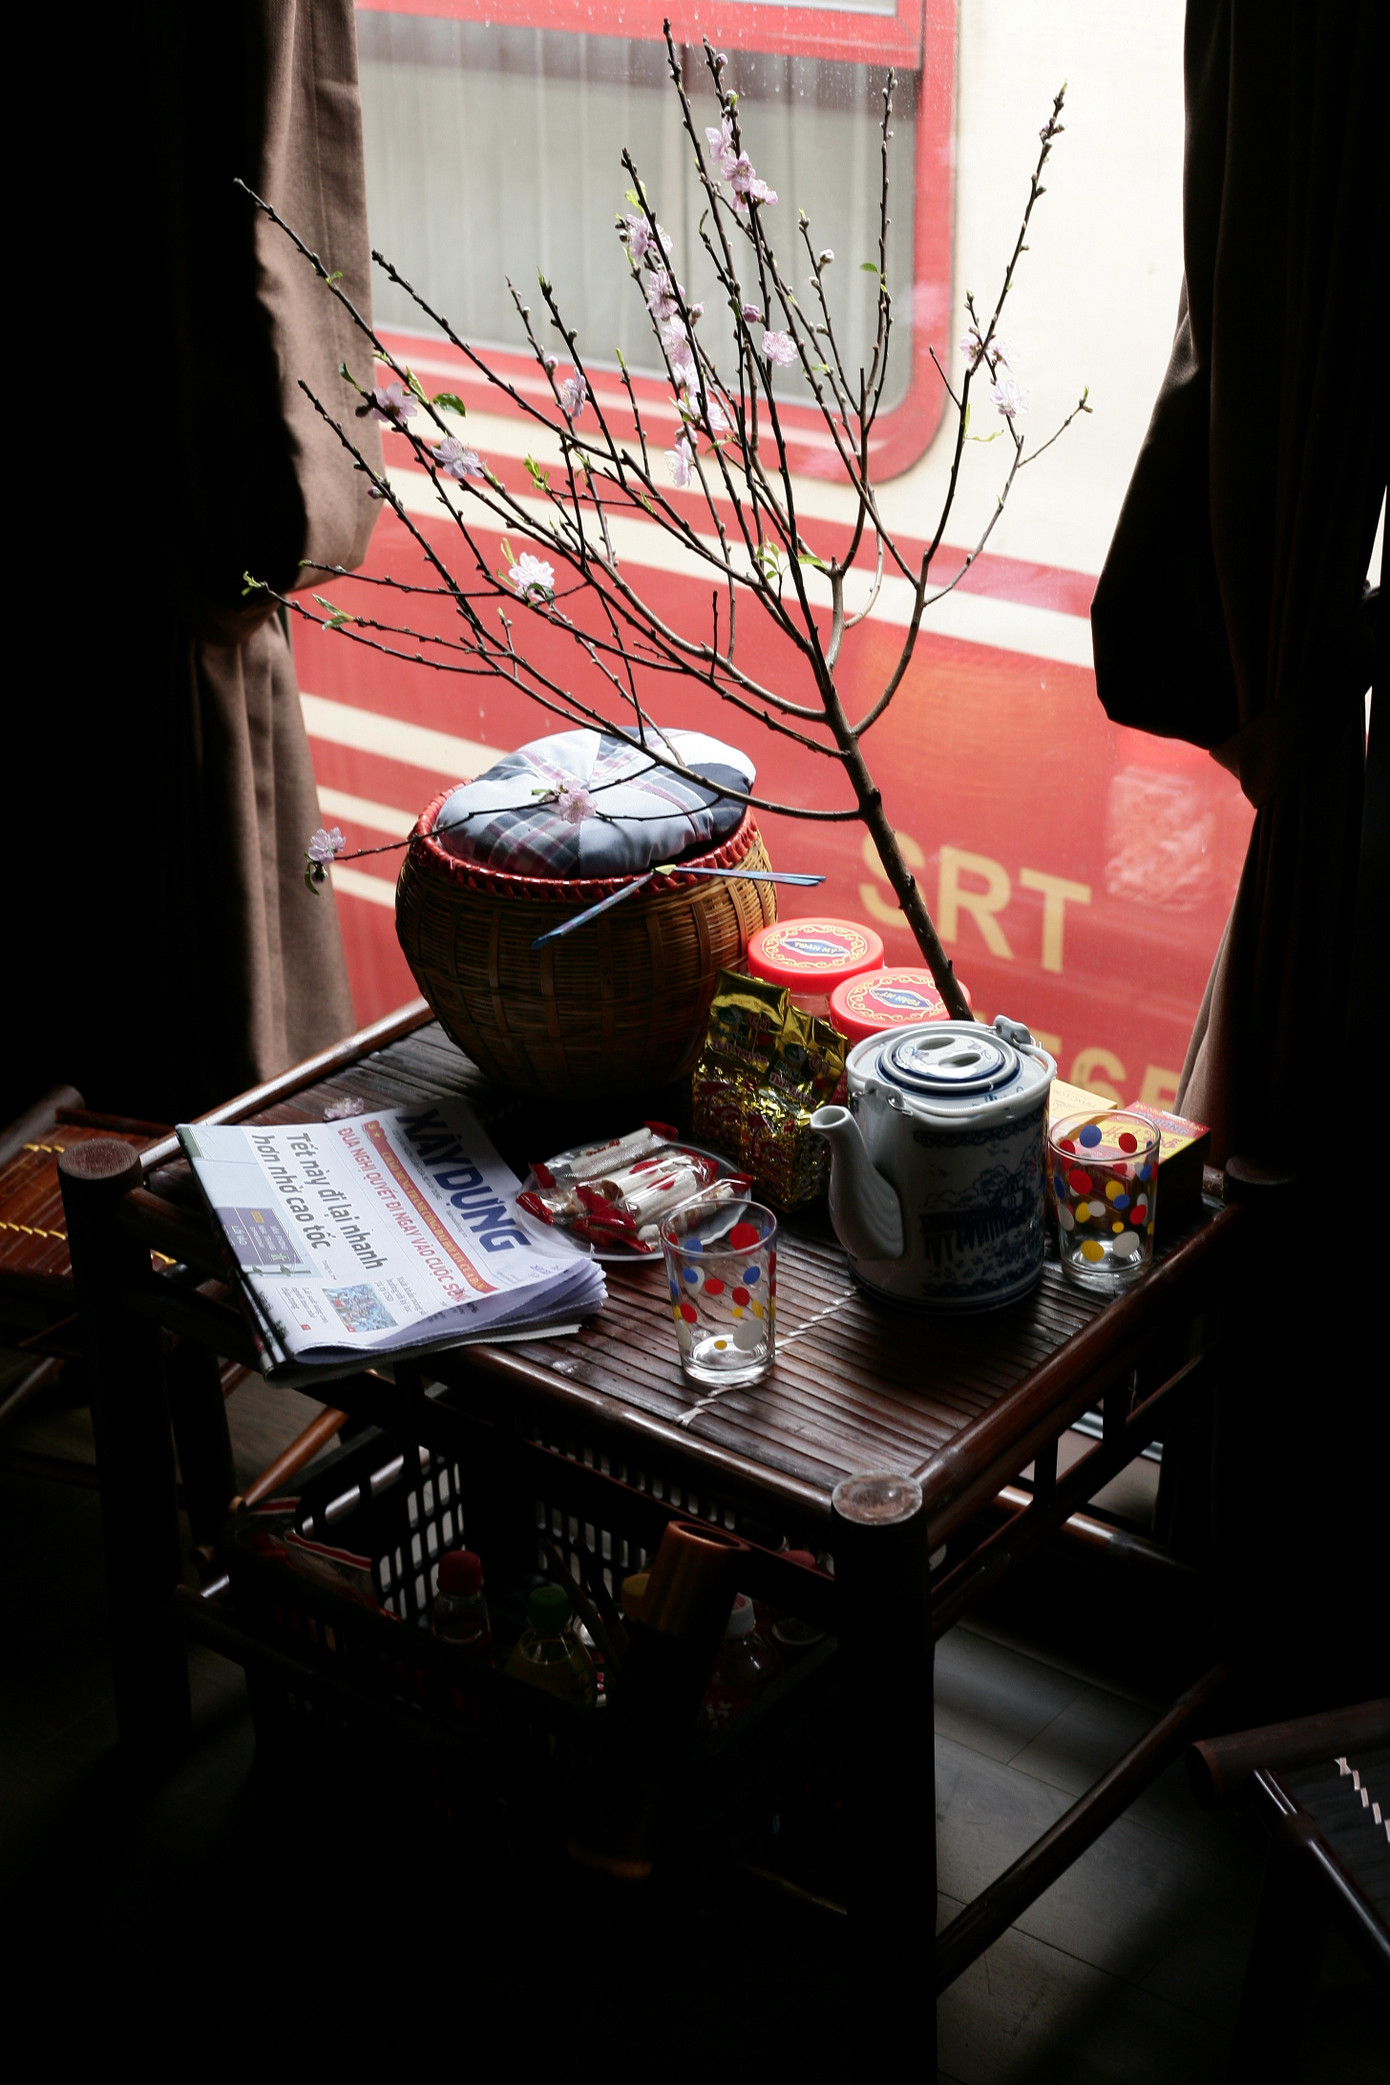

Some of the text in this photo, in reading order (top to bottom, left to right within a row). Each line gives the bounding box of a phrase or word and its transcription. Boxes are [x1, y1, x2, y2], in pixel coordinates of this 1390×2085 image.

[858, 830, 1092, 974] SRT
[287, 1133, 318, 1157] Tết
[338, 1128, 360, 1148] ĐƯA
[394, 1109, 473, 1166] XÂY
[351, 1148, 376, 1171] NGHỊ
[300, 1161, 330, 1185] này
[252, 1135, 280, 1162] hơn
[268, 1167, 303, 1193] nhờ
[286, 1198, 314, 1221] cao
[303, 1225, 336, 1248] tốc
[318, 1189, 346, 1201] đi
[366, 1172, 398, 1199] QUYẾT
[324, 1204, 359, 1222] lại
[386, 1201, 404, 1211] ĐI
[431, 1167, 532, 1252] DỰNG
[393, 1212, 421, 1235] NGAY
[340, 1225, 387, 1269] nhanh
[411, 1238, 435, 1256] VÀO
[425, 1258, 453, 1282] CUỘC
